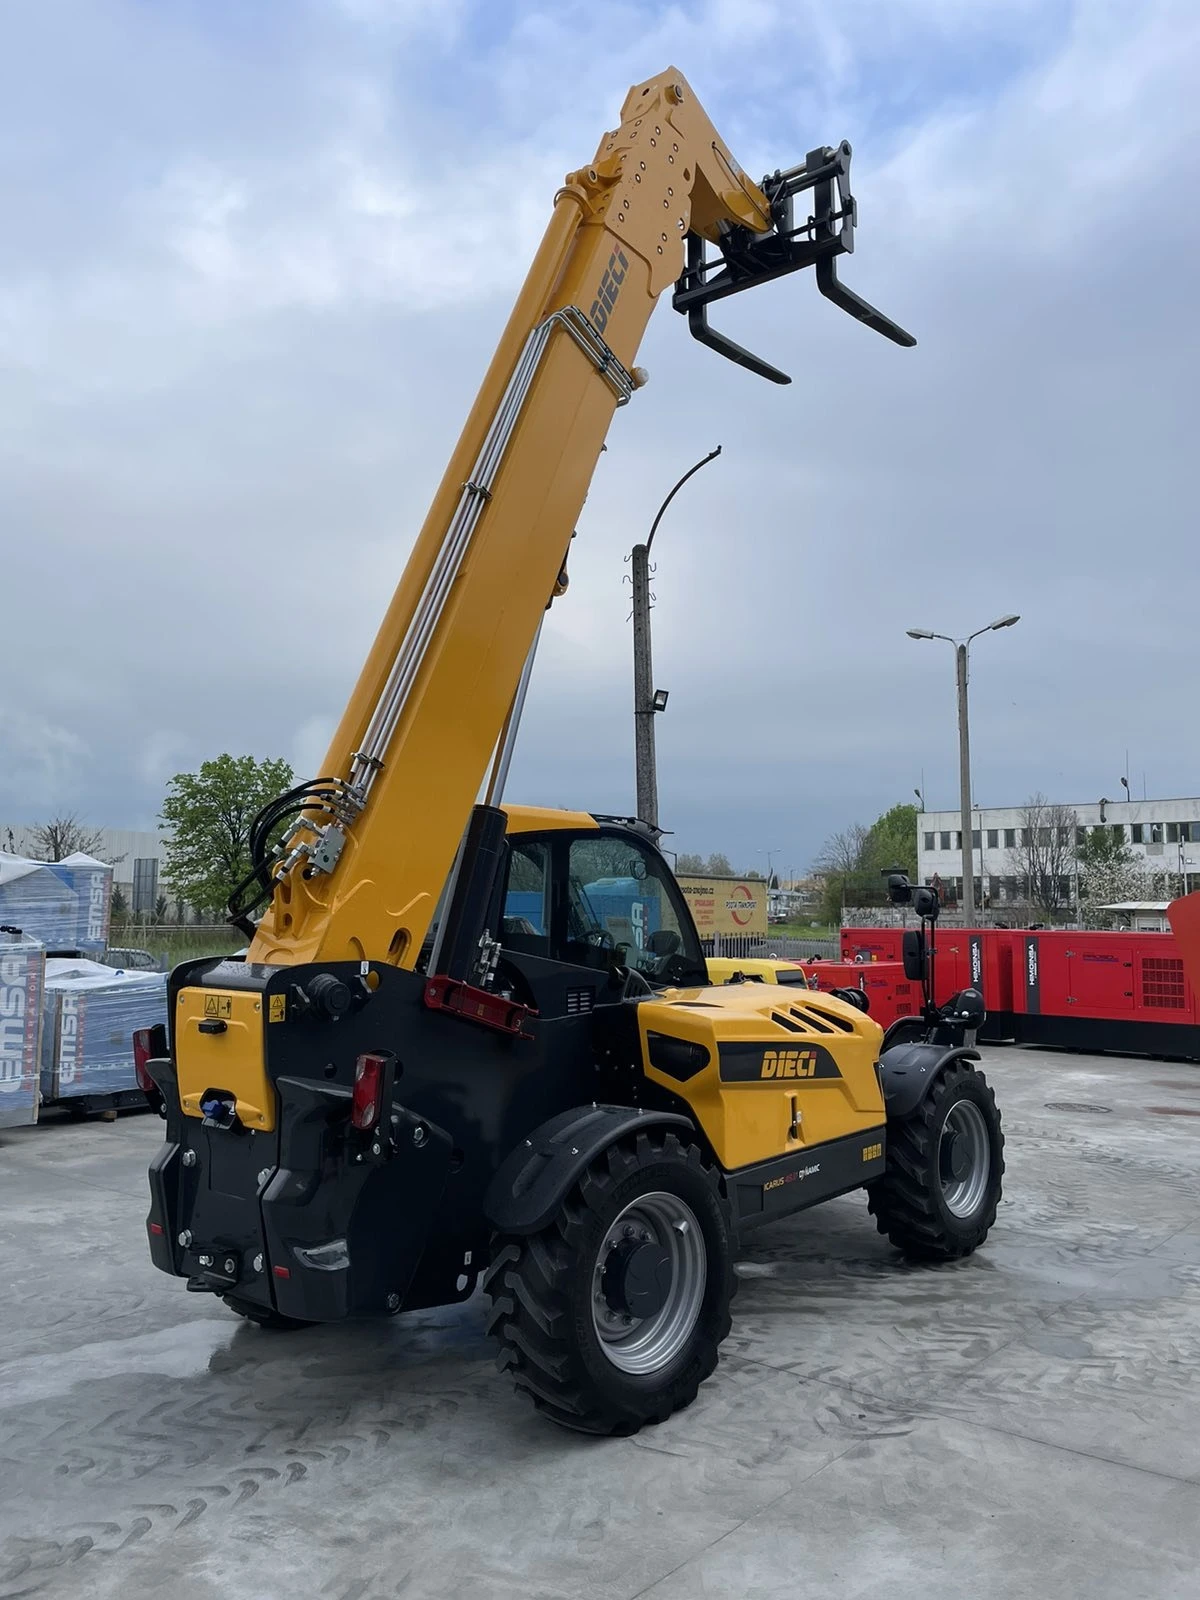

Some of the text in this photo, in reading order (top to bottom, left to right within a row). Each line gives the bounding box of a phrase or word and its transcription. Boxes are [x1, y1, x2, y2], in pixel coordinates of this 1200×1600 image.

[589, 243, 629, 335] DIECI
[761, 1051, 817, 1078] DIECI
[763, 1176, 785, 1192] ICARUS
